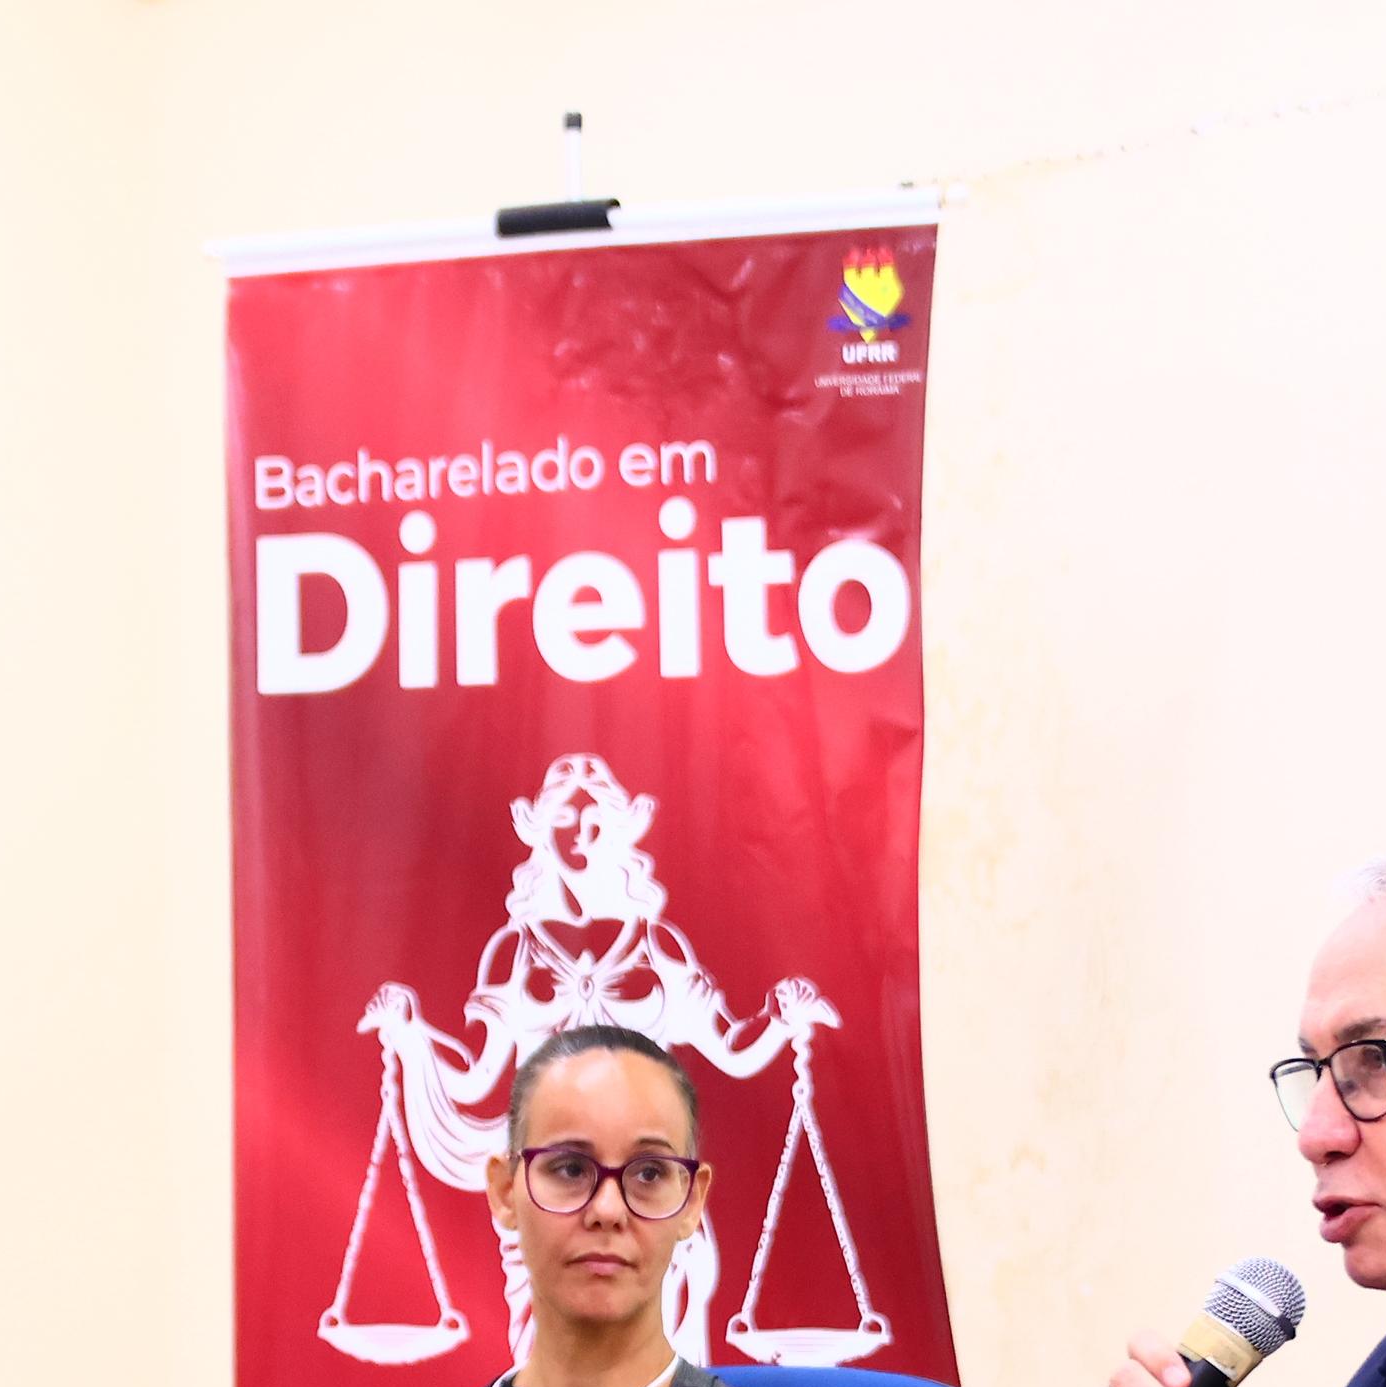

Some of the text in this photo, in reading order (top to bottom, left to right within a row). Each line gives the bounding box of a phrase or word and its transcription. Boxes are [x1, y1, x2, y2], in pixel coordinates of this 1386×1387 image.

[842, 341, 899, 364] UFRR
[815, 373, 881, 388] UNIVERSIDADE
[254, 435, 718, 510] Bacharelado em
[255, 496, 912, 697] Direito
